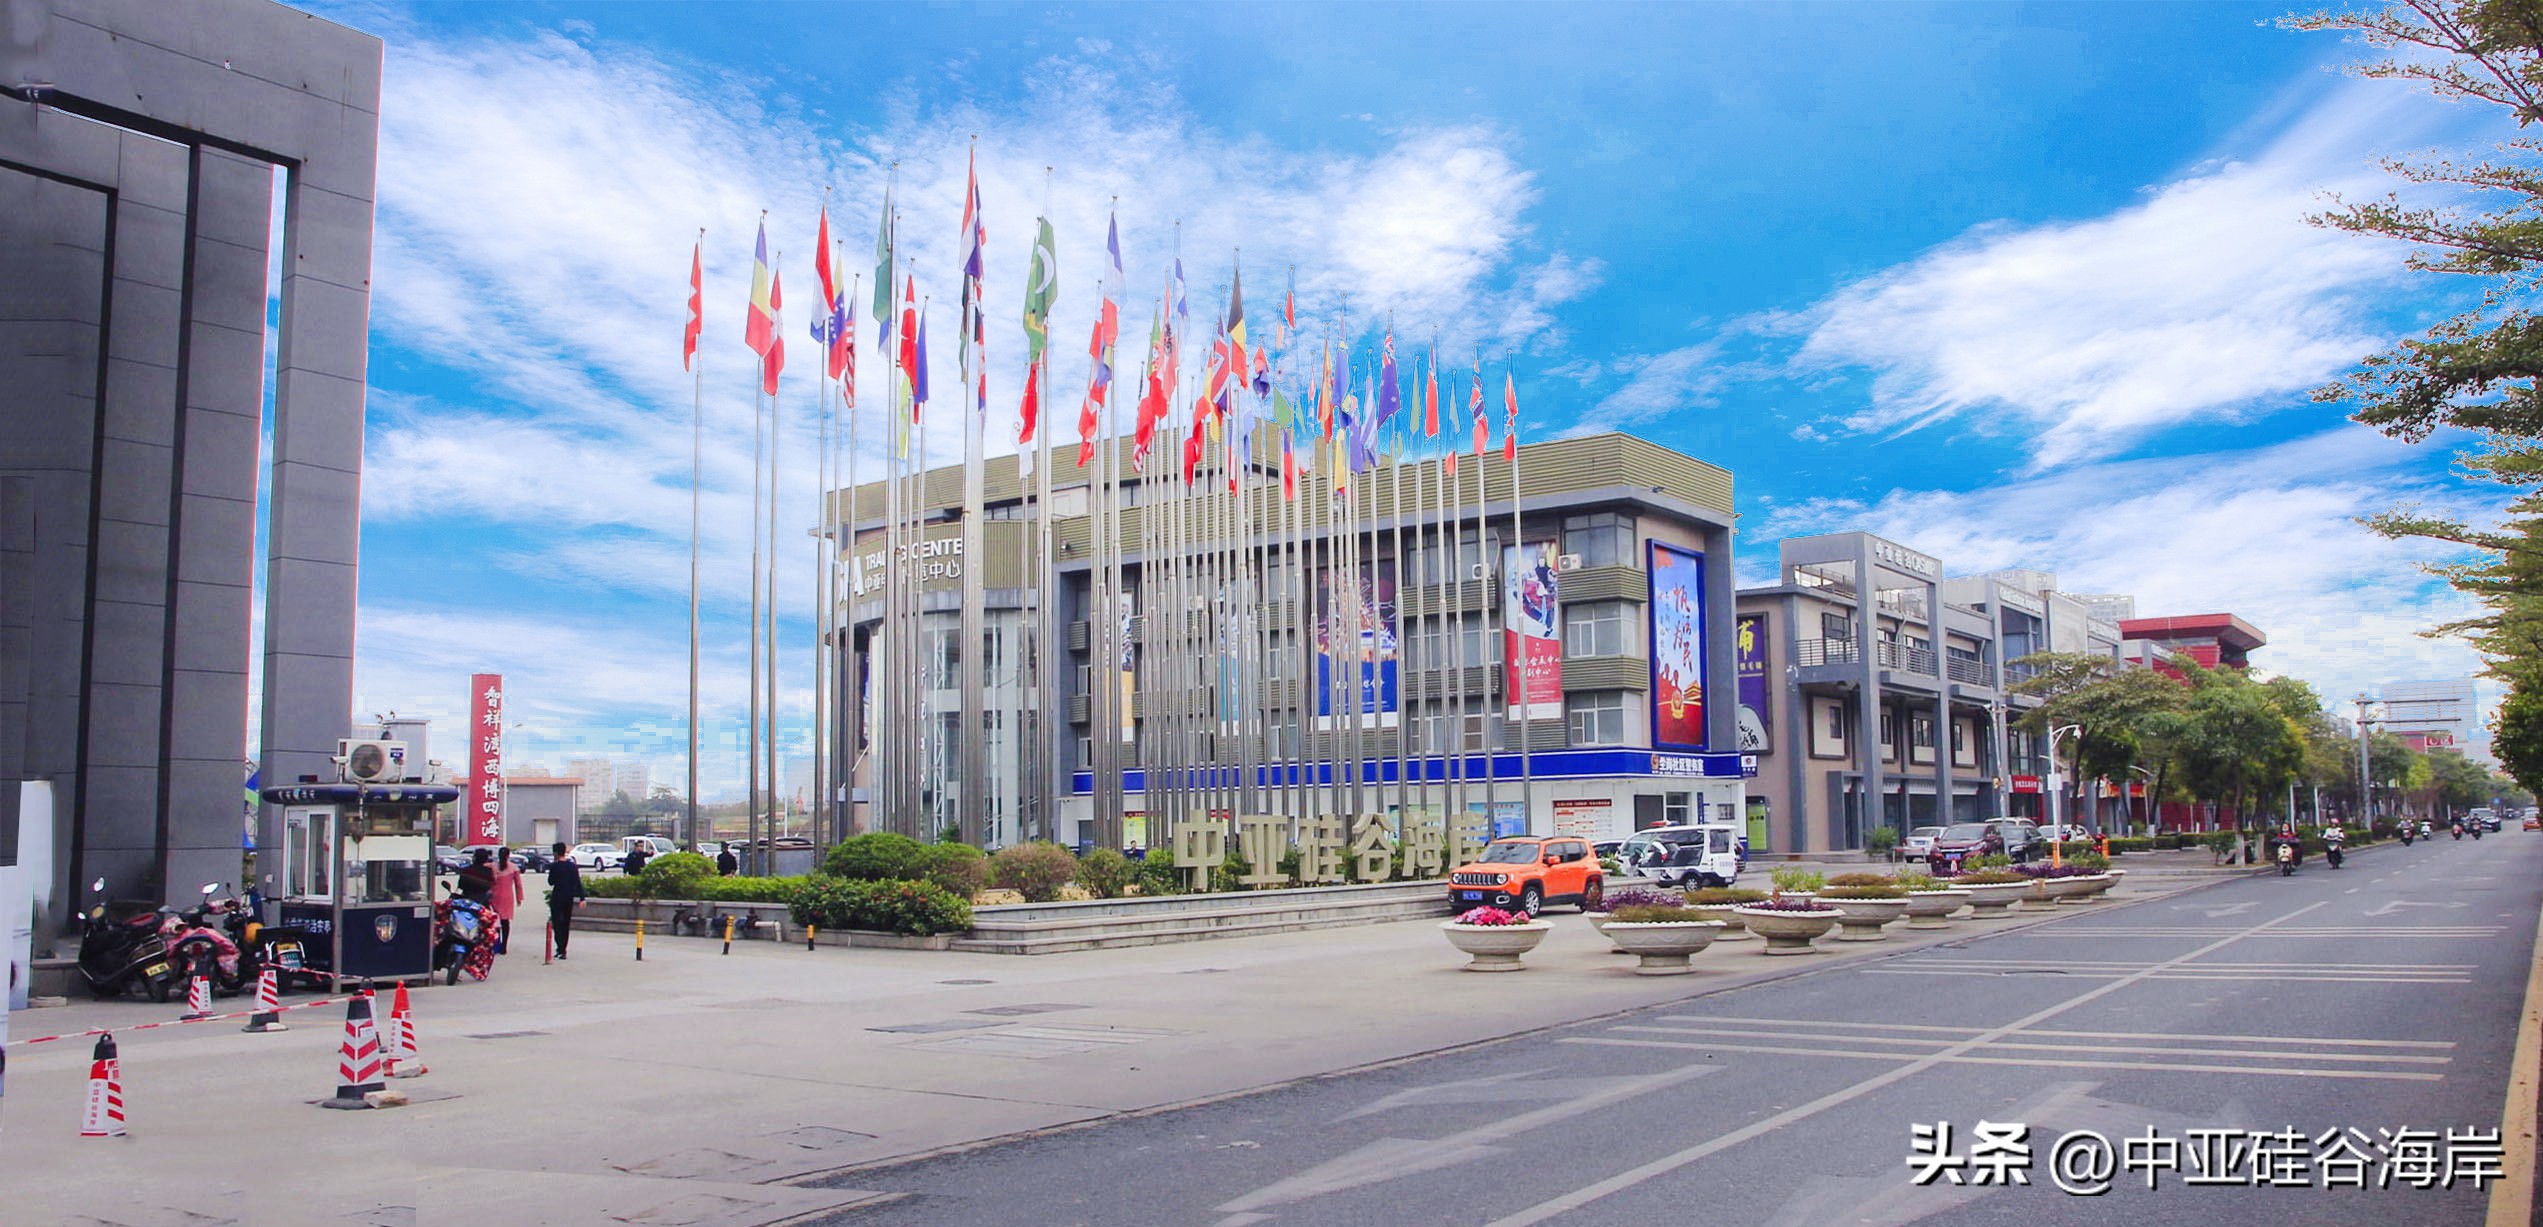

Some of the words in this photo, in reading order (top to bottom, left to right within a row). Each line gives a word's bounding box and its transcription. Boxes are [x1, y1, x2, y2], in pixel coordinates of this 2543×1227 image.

[1173, 808, 1488, 891] 中亚硅谷海岸
